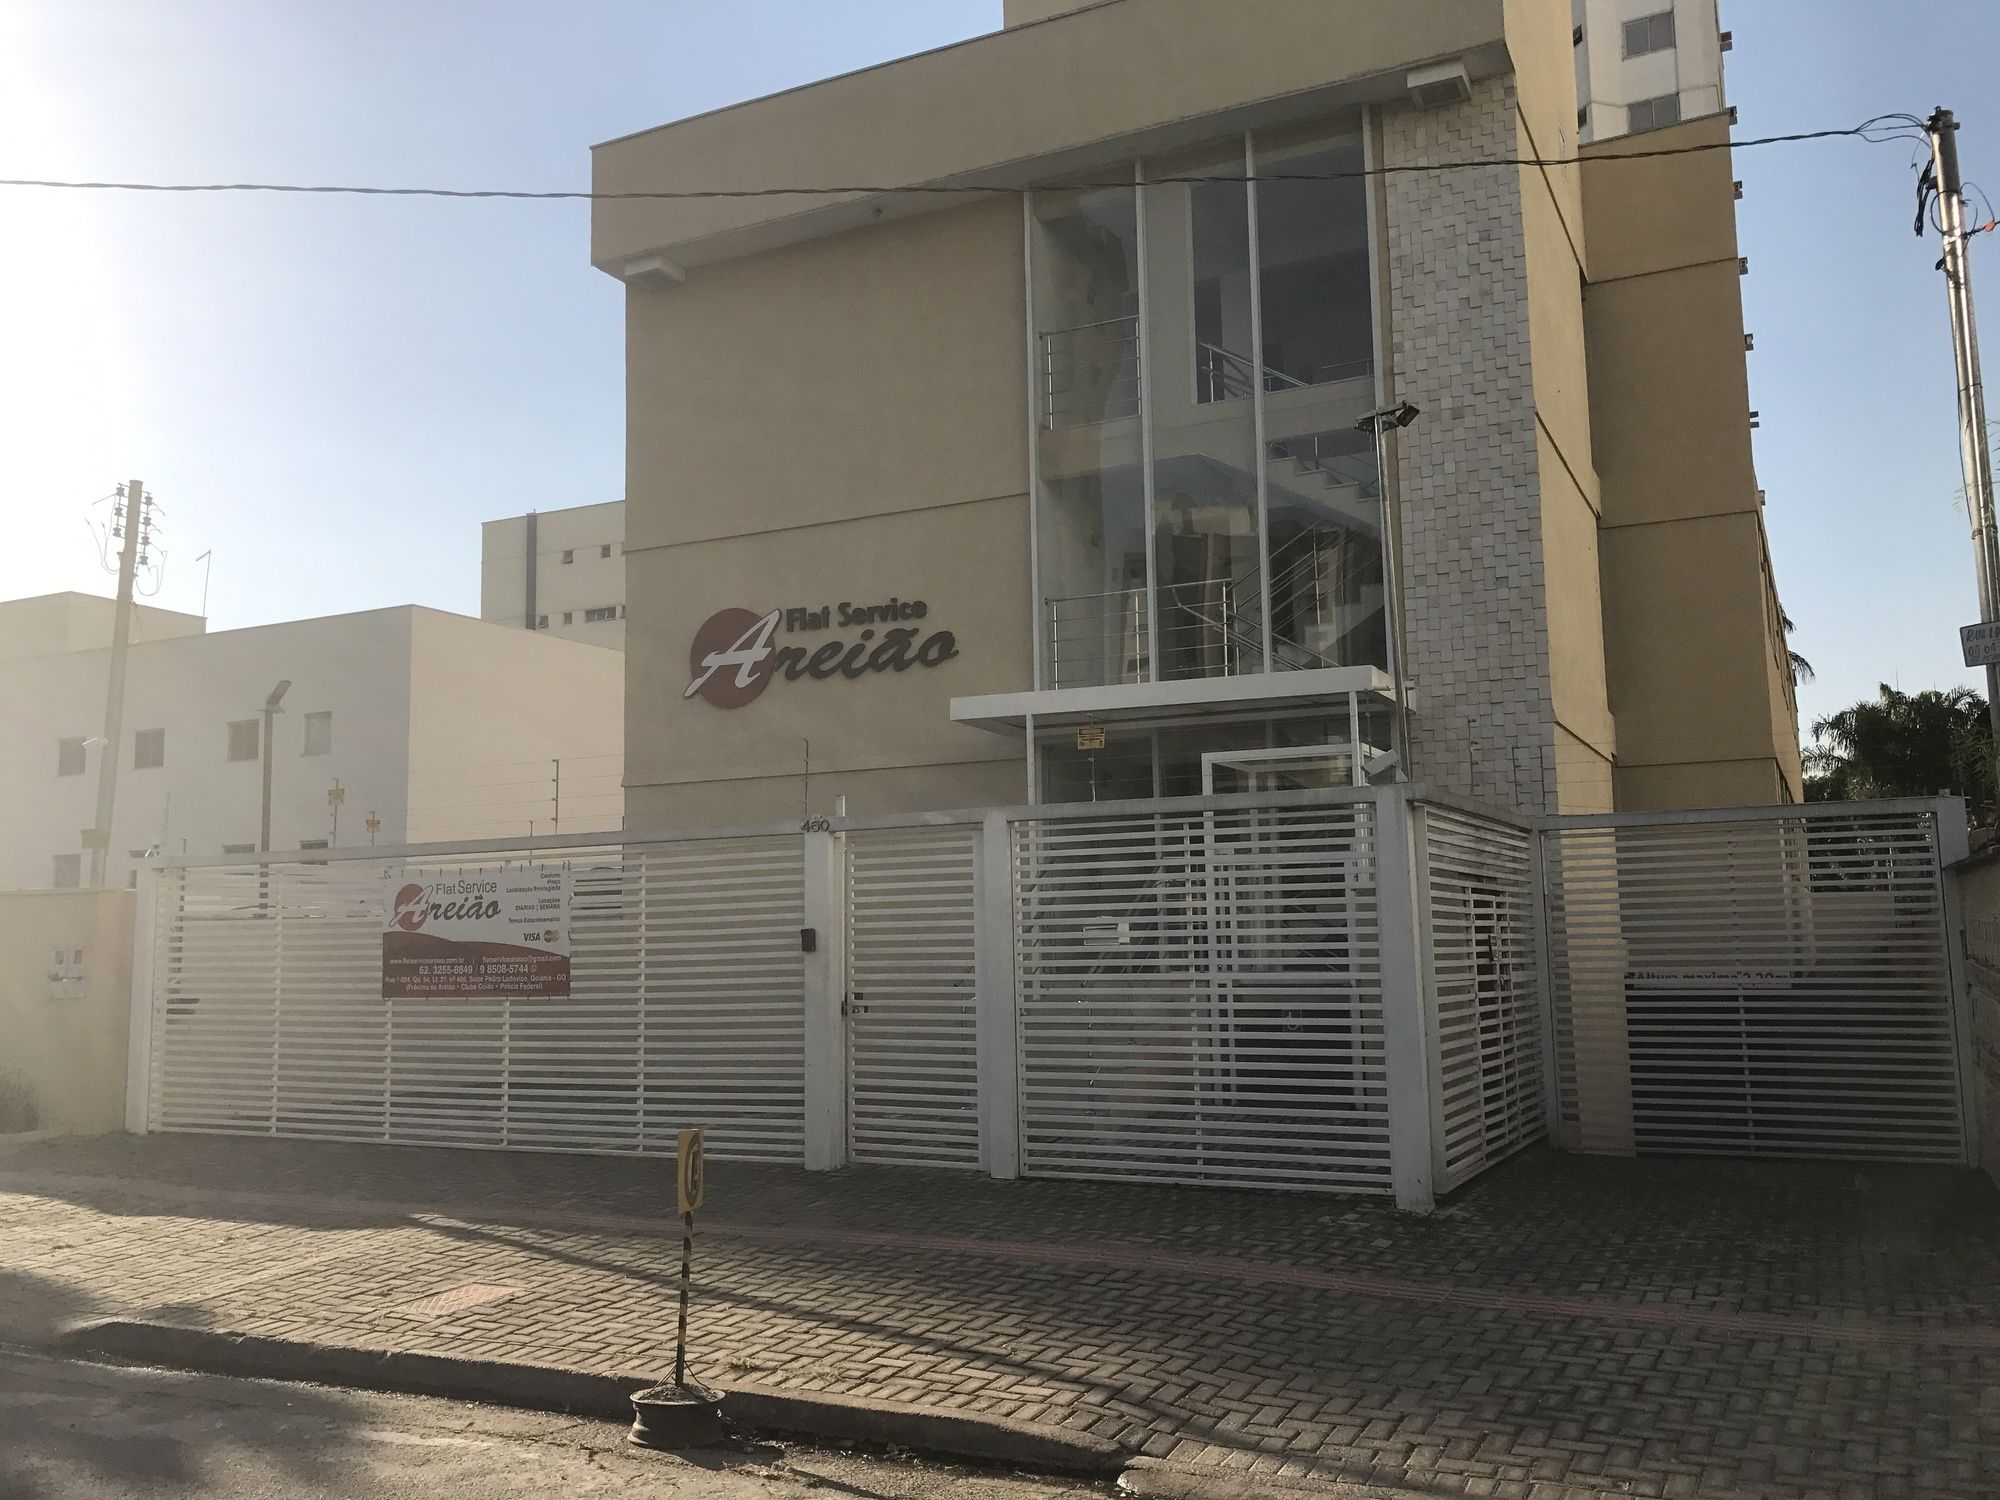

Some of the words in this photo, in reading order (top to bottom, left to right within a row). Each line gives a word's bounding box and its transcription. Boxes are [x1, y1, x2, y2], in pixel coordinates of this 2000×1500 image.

[786, 605, 830, 632] Flat
[838, 597, 928, 627] Service
[684, 607, 960, 698] Areião
[801, 819, 830, 833] 460
[435, 883, 457, 895] Flat
[458, 879, 498, 895] Service
[388, 885, 501, 928] Areião
[523, 932, 541, 941] VISA
